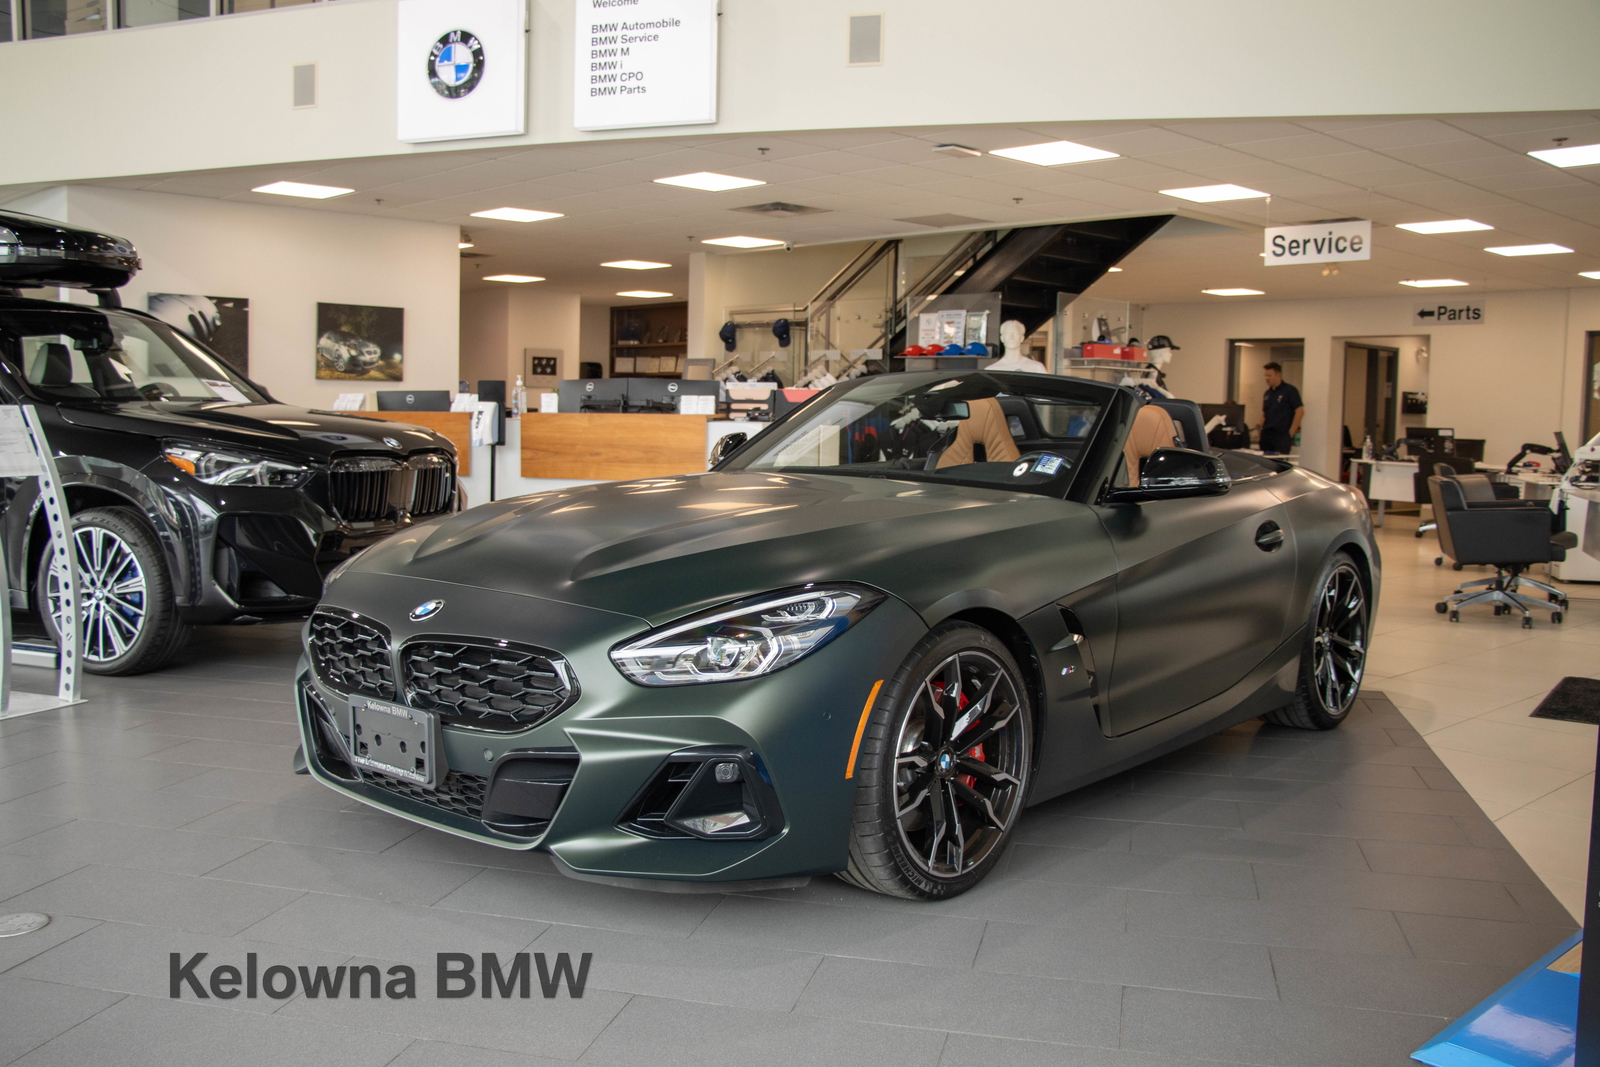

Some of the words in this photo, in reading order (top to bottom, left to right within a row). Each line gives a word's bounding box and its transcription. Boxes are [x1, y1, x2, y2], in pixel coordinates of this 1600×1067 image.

[593, 0, 639, 8] Welcome
[591, 23, 619, 34] BMW
[621, 18, 681, 31] Automobile
[432, 30, 481, 55] BMW
[591, 36, 618, 46] BMW
[620, 33, 659, 44] Service
[591, 48, 618, 59] BMW
[620, 47, 630, 56] M
[591, 61, 618, 71] BMW
[619, 61, 623, 69] i
[590, 73, 618, 84] BMW
[620, 71, 644, 82] CPO
[590, 86, 617, 97] BMW
[620, 85, 647, 95] Parts
[1271, 231, 1363, 257] Service
[1436, 305, 1482, 321] Parts
[100, 518, 125, 534] ZERO
[366, 700, 391, 714] Kelowna
[391, 706, 408, 718] BMW
[354, 756, 366, 764] The
[386, 765, 403, 776] Driving
[891, 842, 923, 887] MICHELIN
